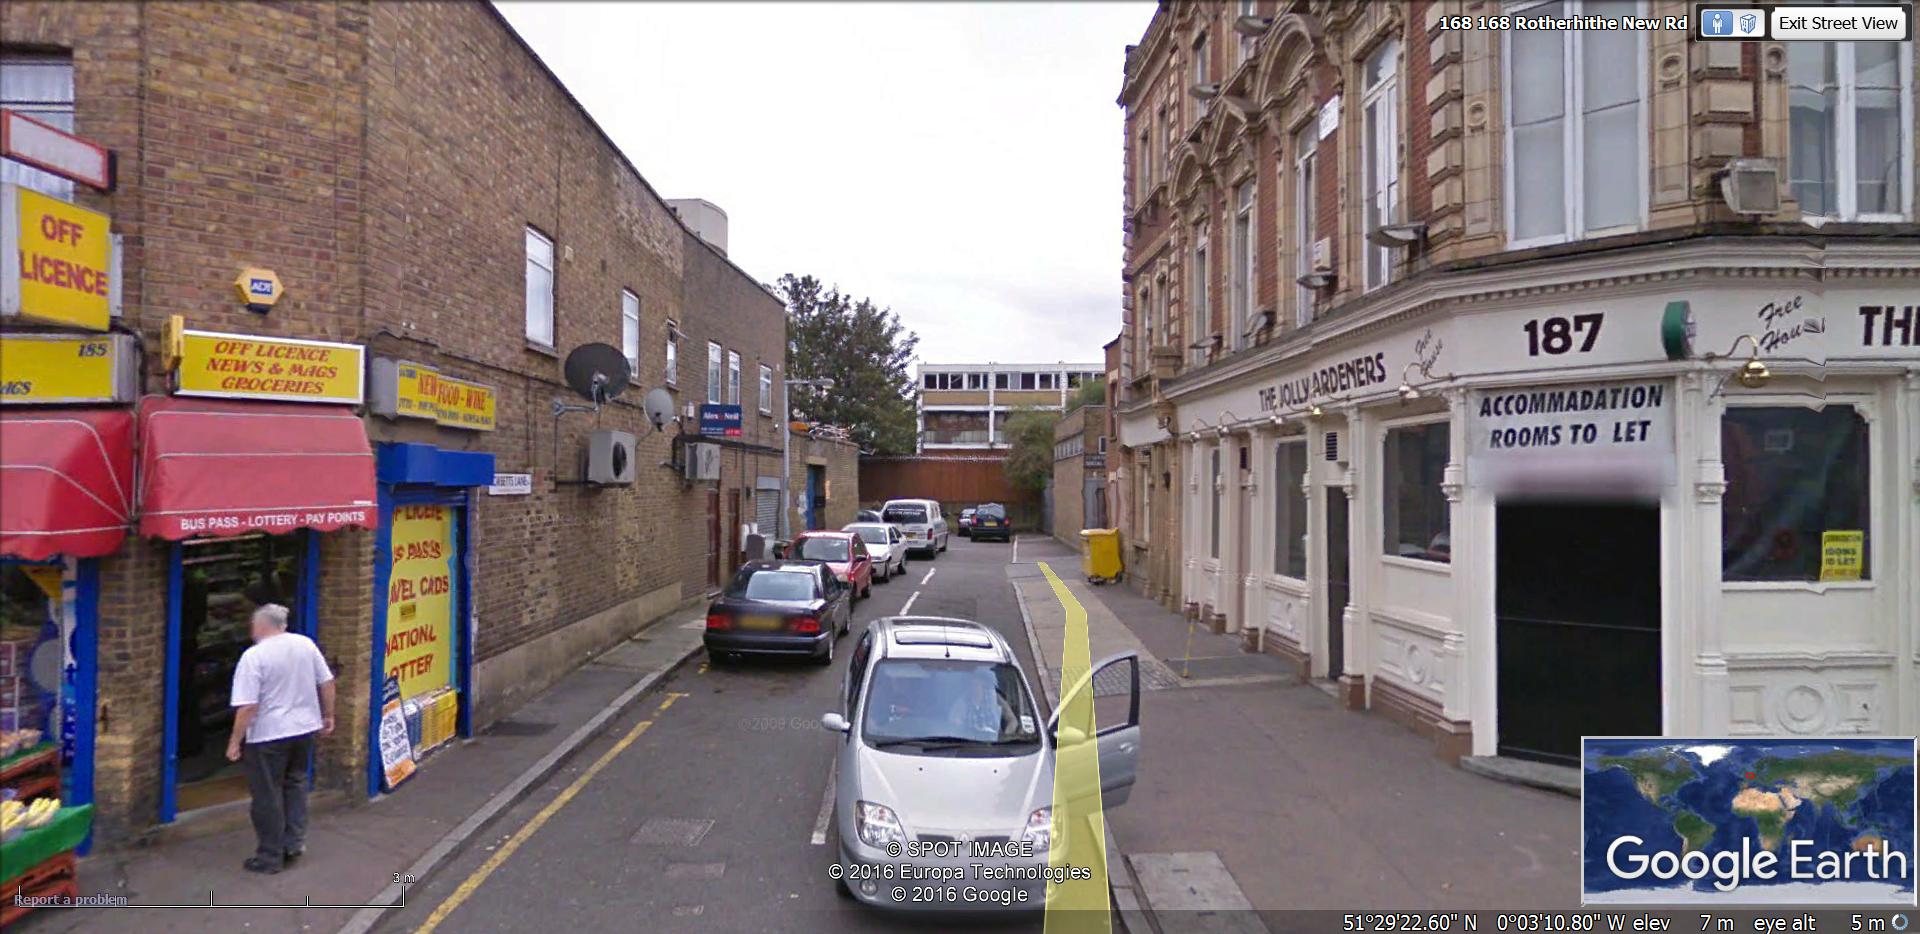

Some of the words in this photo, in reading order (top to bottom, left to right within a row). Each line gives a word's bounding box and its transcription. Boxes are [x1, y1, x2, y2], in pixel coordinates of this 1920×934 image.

[41, 214, 84, 247] OFF
[19, 251, 109, 296] LICENCE
[252, 280, 272, 293] ADT
[1758, 295, 1802, 329] Free
[1523, 312, 1604, 357] 187
[206, 358, 264, 375] NEWS
[265, 361, 284, 375] &
[215, 340, 251, 358] OFF
[256, 343, 331, 362] LICENCE
[221, 375, 325, 395] GROCERIES
[1258, 386, 1277, 411] THE
[1279, 377, 1312, 409] JOLLY
[1479, 384, 1664, 418] ACCOMMADATION
[1490, 425, 1562, 449] ROOMS
[1569, 423, 1597, 445] TO
[1613, 419, 1652, 443] LET
[181, 518, 205, 530] BUS
[208, 516, 239, 529] PASS
[248, 514, 298, 527] LOTTERY
[306, 512, 326, 524] PAY
[327, 510, 366, 523] POINTS
